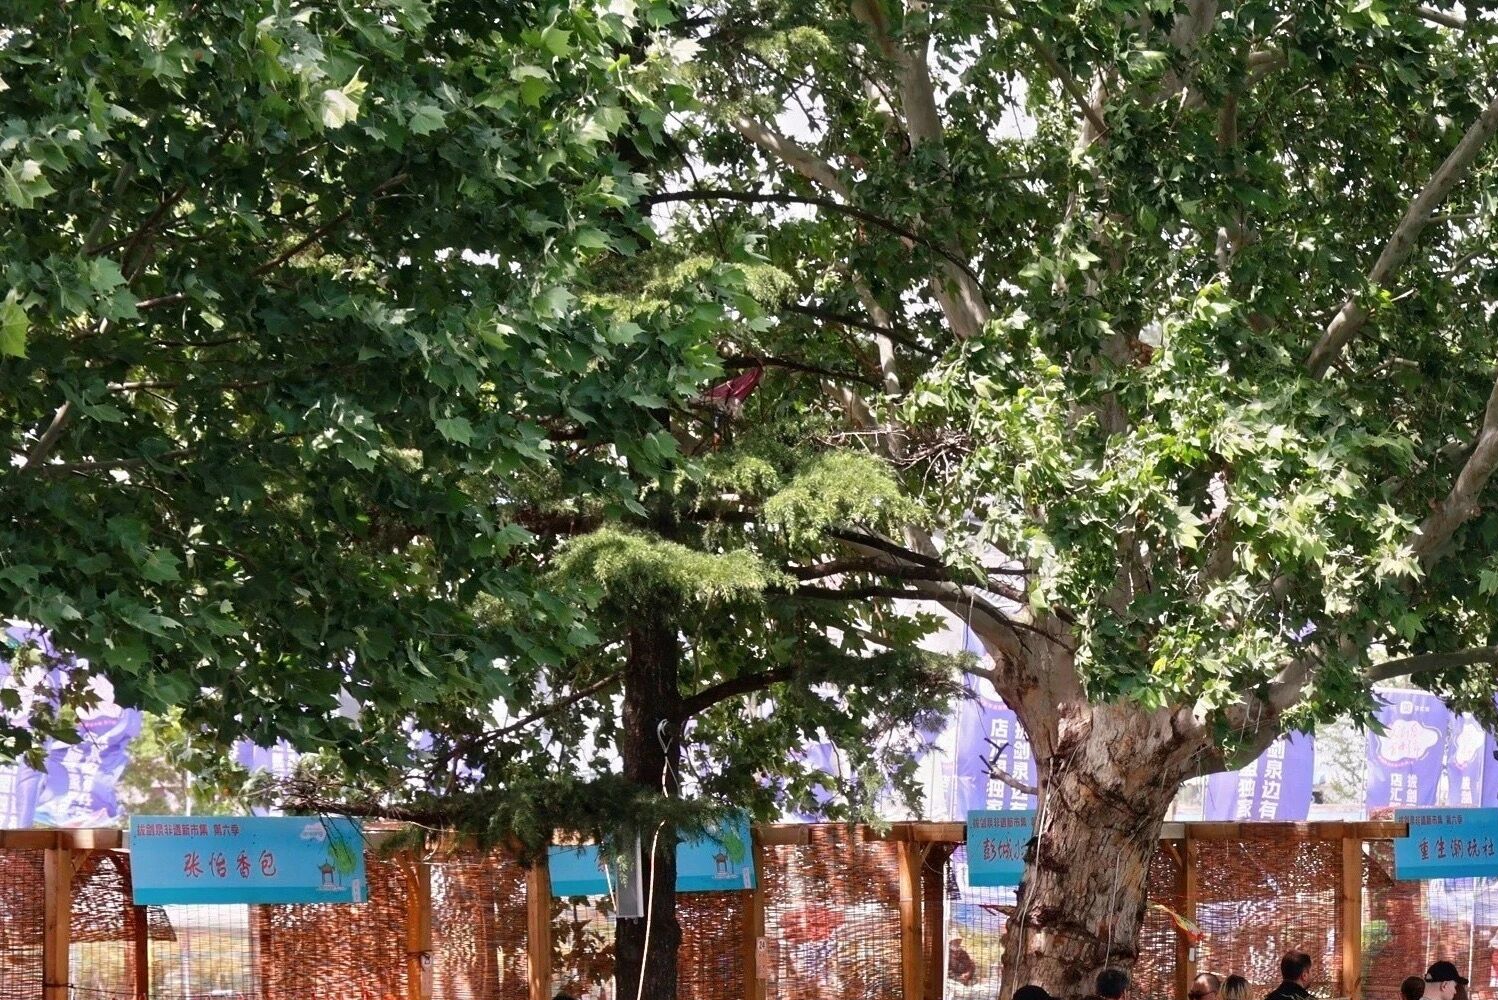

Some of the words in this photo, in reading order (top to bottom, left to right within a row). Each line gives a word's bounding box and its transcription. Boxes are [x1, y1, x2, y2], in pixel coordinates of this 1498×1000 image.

[1390, 773, 1404, 807] 店汇
[183, 850, 277, 879] 张怡香包
